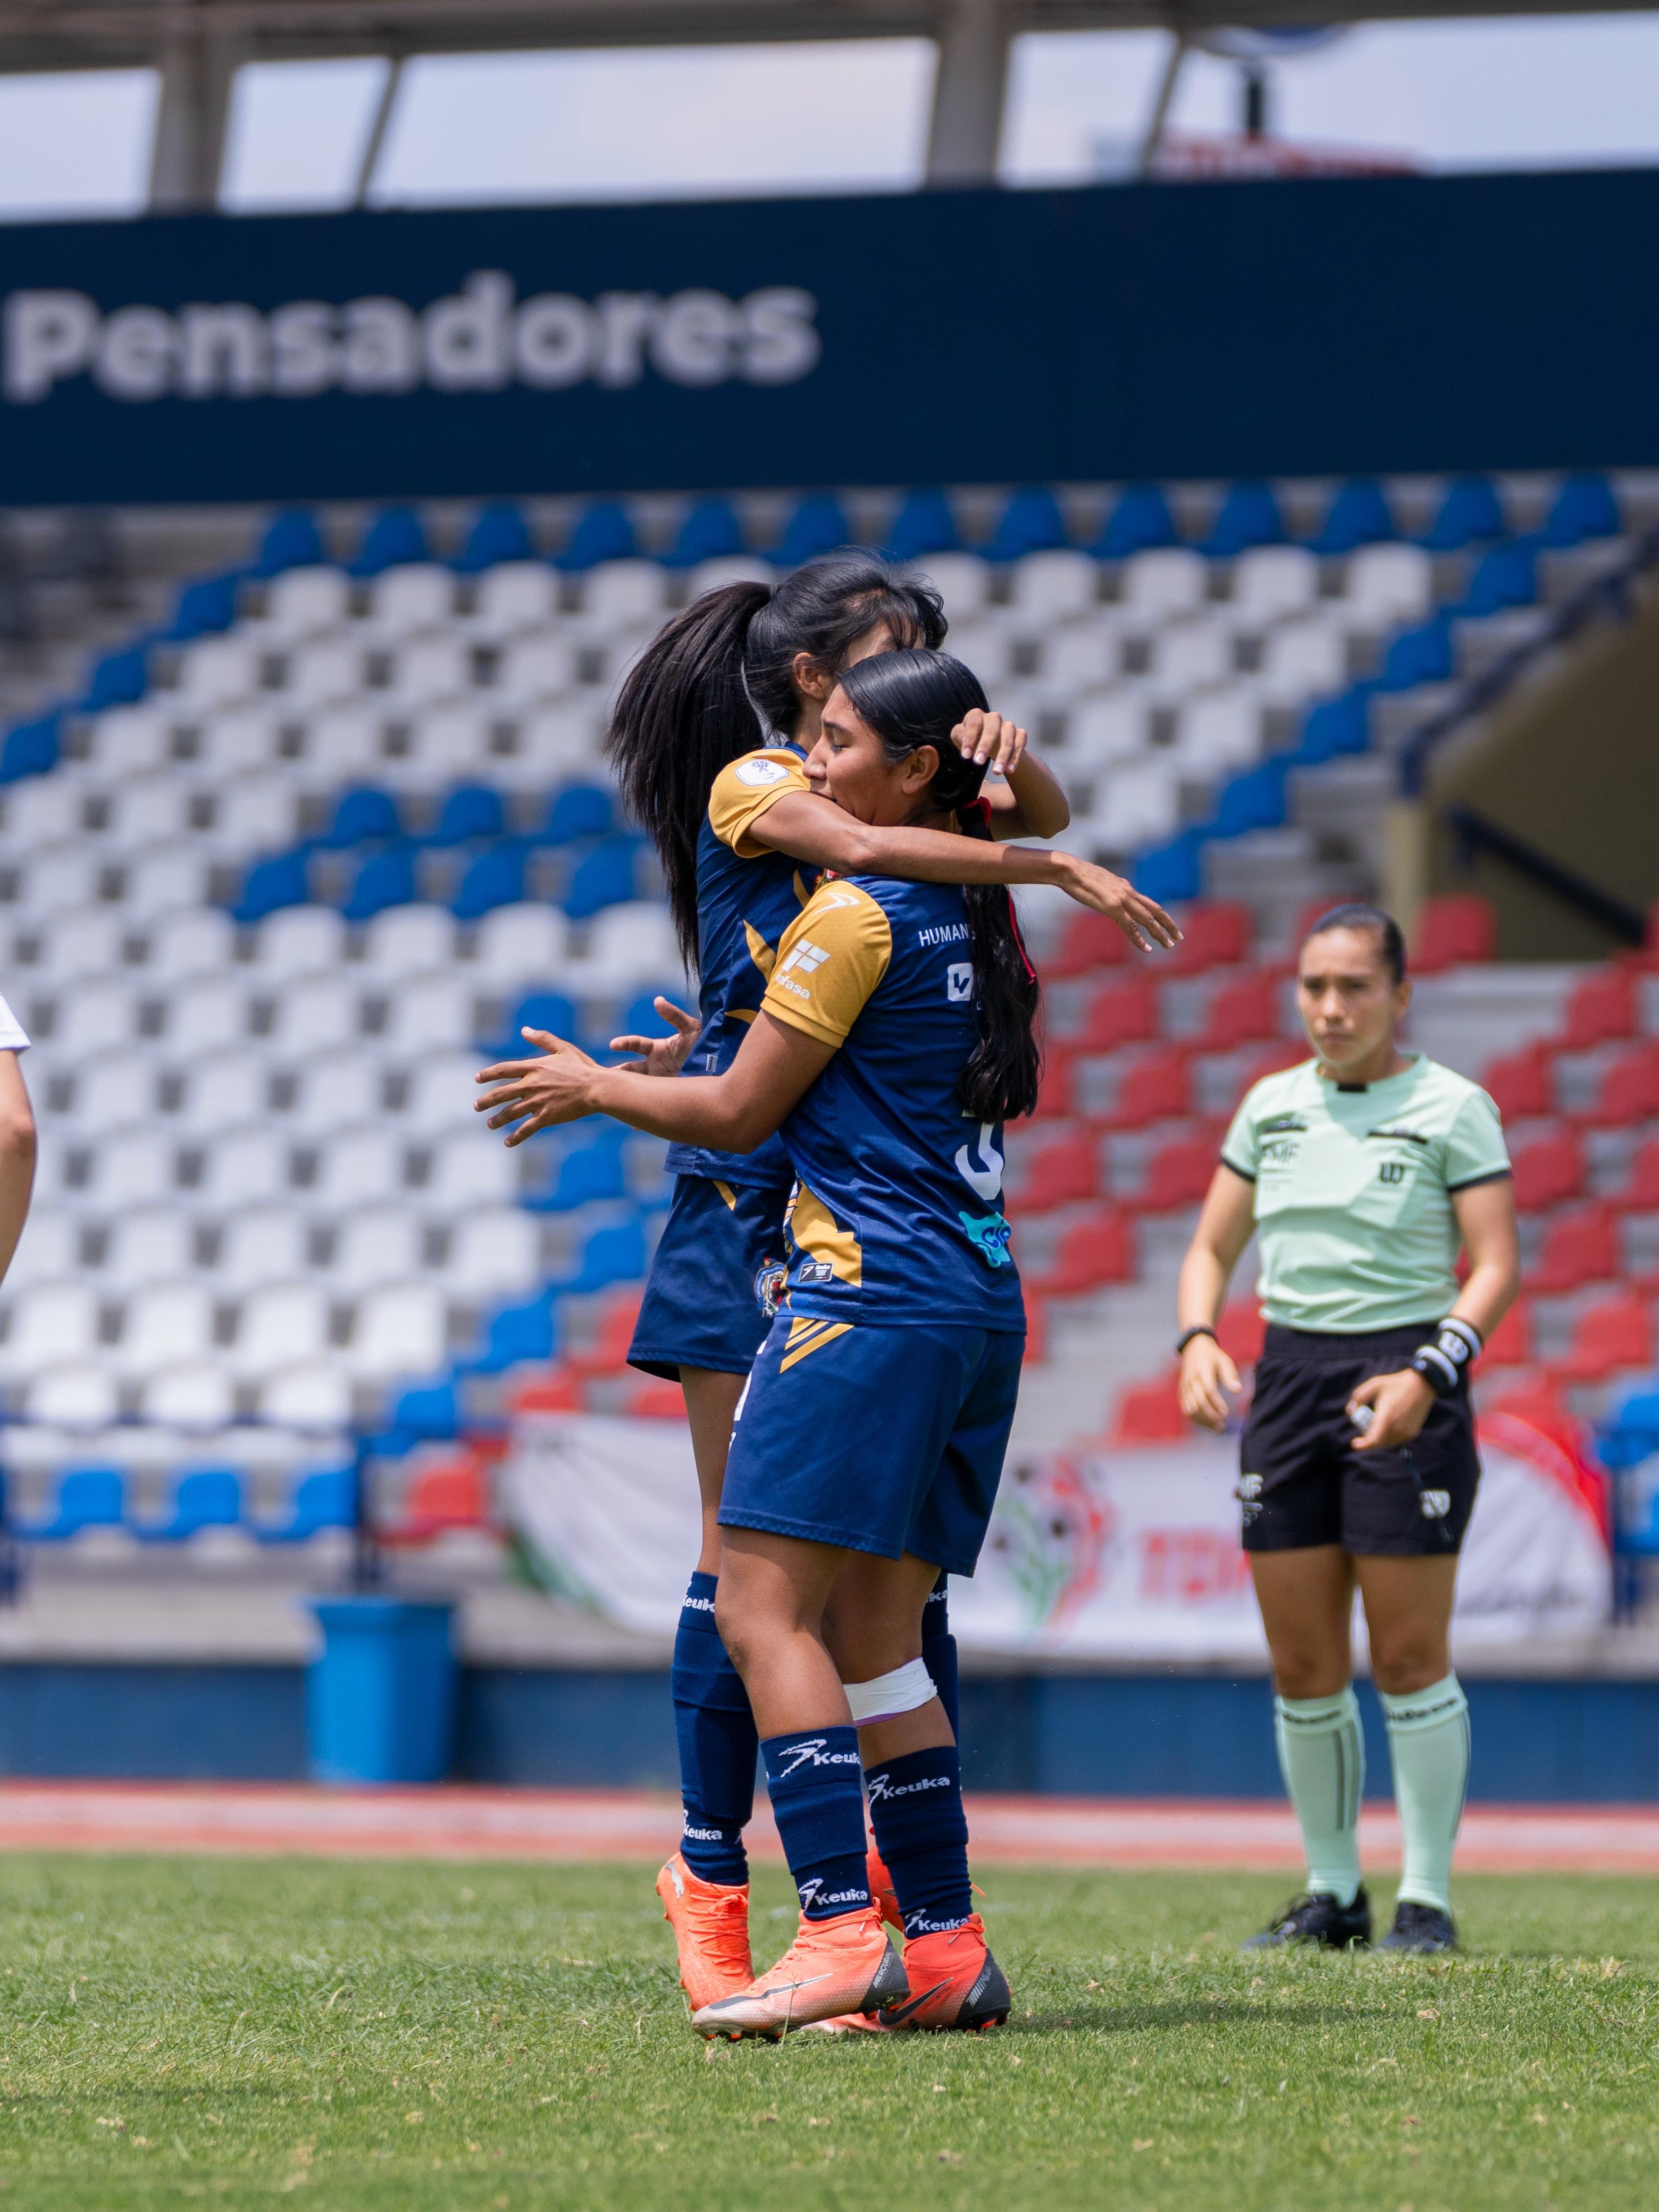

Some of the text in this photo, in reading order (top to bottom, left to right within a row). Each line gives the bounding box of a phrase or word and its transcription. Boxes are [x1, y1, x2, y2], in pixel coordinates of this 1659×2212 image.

[4, 270, 820, 401] Pensadores
[813, 1752, 861, 1766] Keuk
[882, 1776, 951, 1800] Keuka
[683, 1824, 723, 1840] Keuka
[814, 1888, 868, 1905] Keuka
